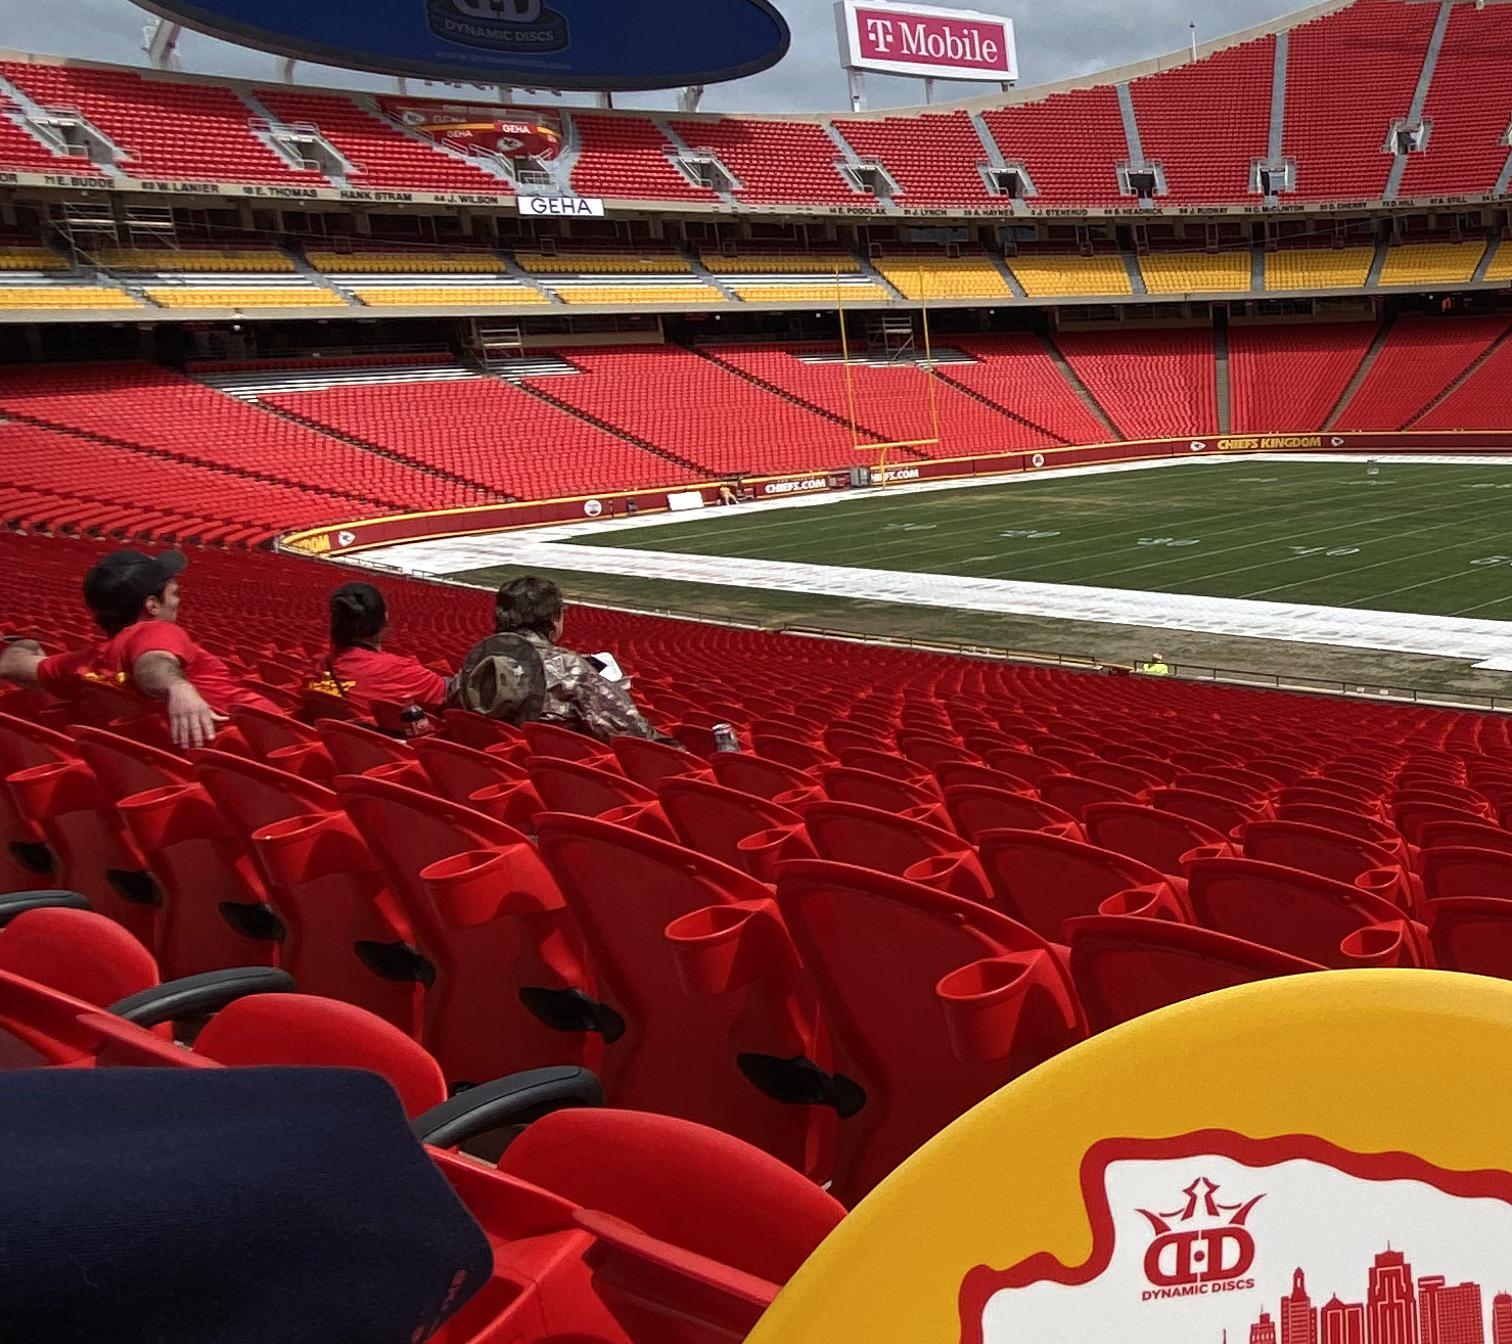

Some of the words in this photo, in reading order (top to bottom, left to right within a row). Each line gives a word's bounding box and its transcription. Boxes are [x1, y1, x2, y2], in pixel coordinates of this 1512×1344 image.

[444, 19, 513, 41] DYNAMIC
[515, 30, 554, 42] DISCS
[897, 21, 998, 63] Mobile
[502, 123, 531, 134] GEHA
[71, 178, 116, 188] BUDDE
[173, 183, 220, 193] LANIER
[268, 188, 318, 198] THOMAS
[374, 191, 412, 201] STRAM
[459, 195, 498, 204] WILSON
[531, 197, 592, 215] GEHA
[1217, 438, 1259, 449] CHIEFS
[1261, 436, 1322, 448] KINGDOM
[765, 478, 826, 494] CHIEFS.COM
[1142, 1284, 1208, 1301] DYNAMIC
[1212, 1278, 1255, 1293] DISCS
